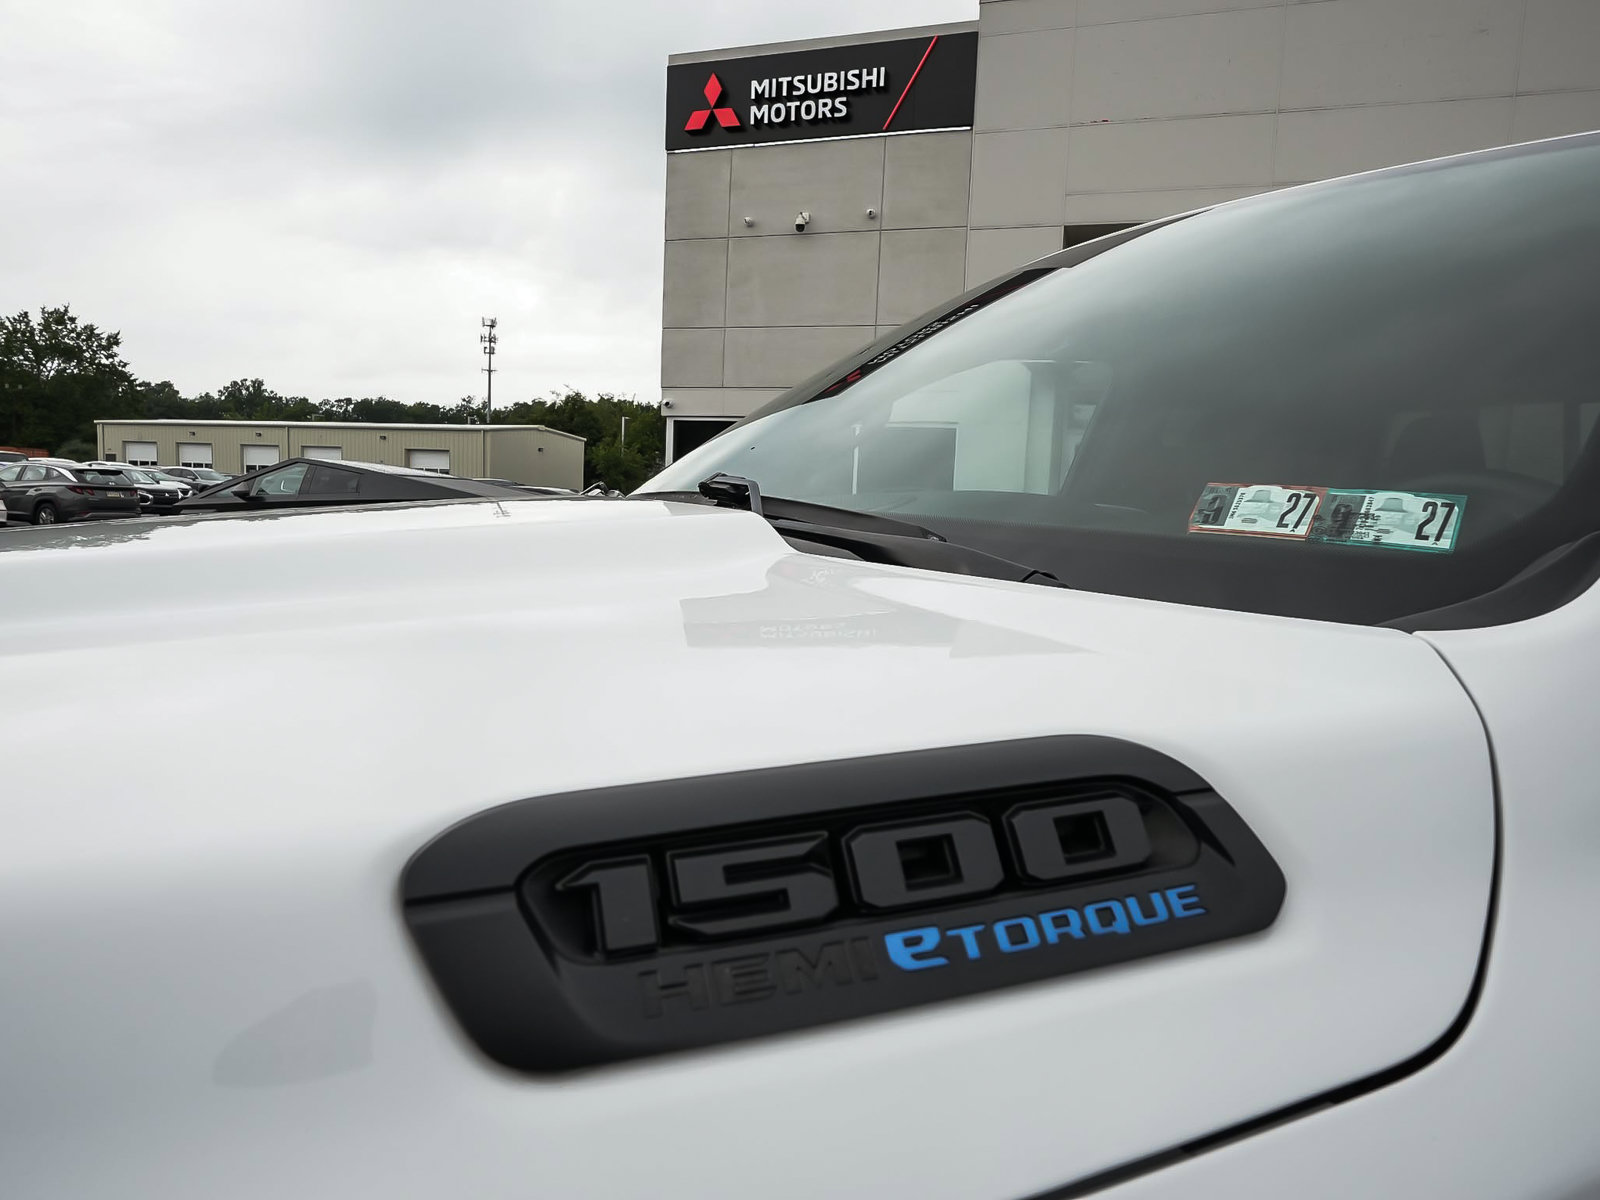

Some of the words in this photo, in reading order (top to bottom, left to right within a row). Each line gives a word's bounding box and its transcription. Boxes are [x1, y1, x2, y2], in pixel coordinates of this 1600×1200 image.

[750, 66, 886, 100] MITSUBISHI
[750, 96, 848, 125] MOTORS
[1276, 492, 1318, 528] 27
[1415, 501, 1456, 542] 27
[555, 790, 1155, 953] 1500
[638, 934, 878, 1019] HEMI
